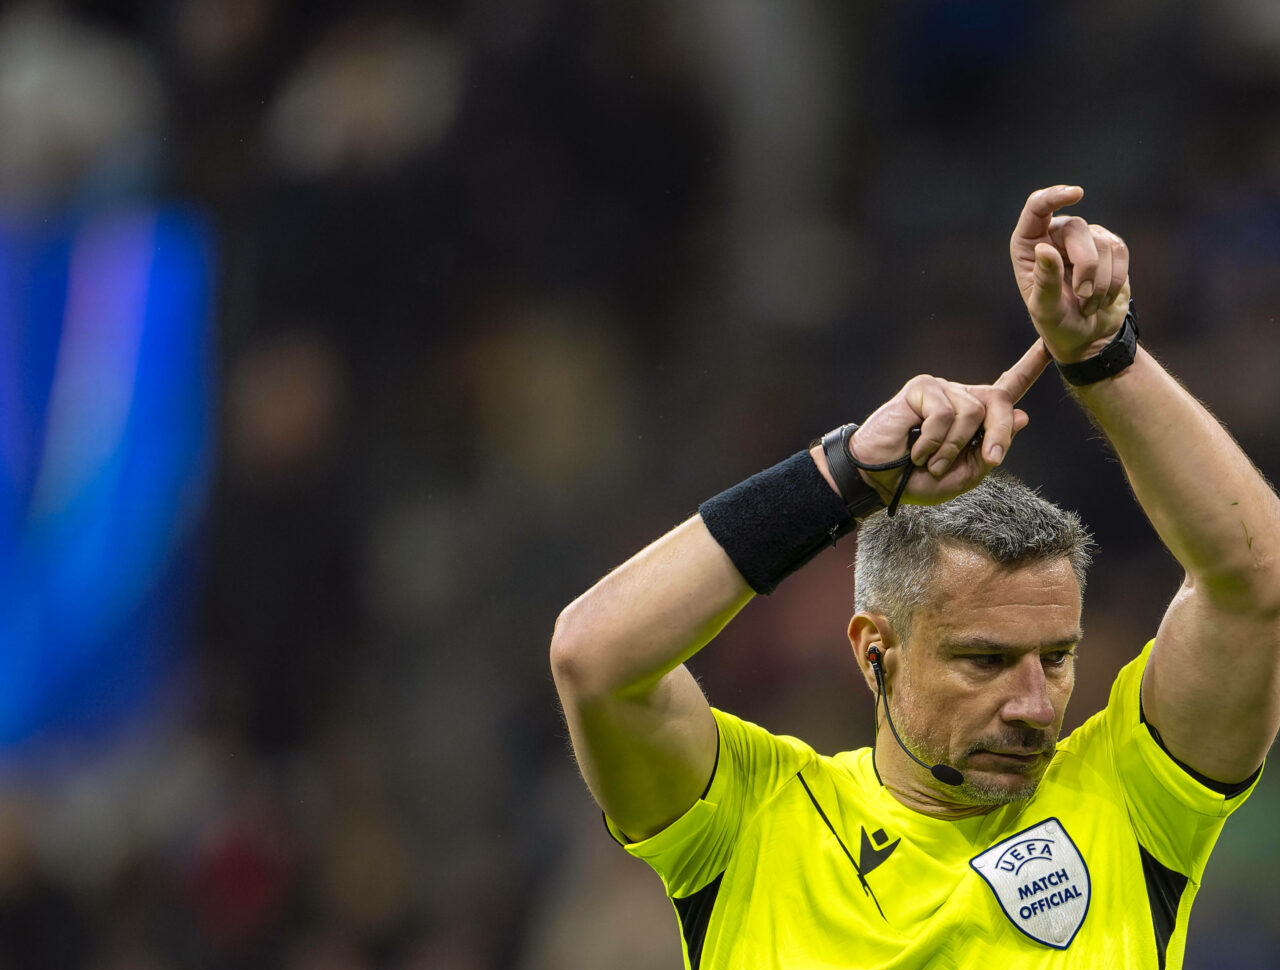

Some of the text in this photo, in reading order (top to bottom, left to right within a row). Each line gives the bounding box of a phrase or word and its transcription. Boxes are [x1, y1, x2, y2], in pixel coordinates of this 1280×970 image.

[1000, 843, 1053, 873] UEFA
[1017, 868, 1069, 901] MATCH
[1019, 884, 1082, 920] OFFICIAL
